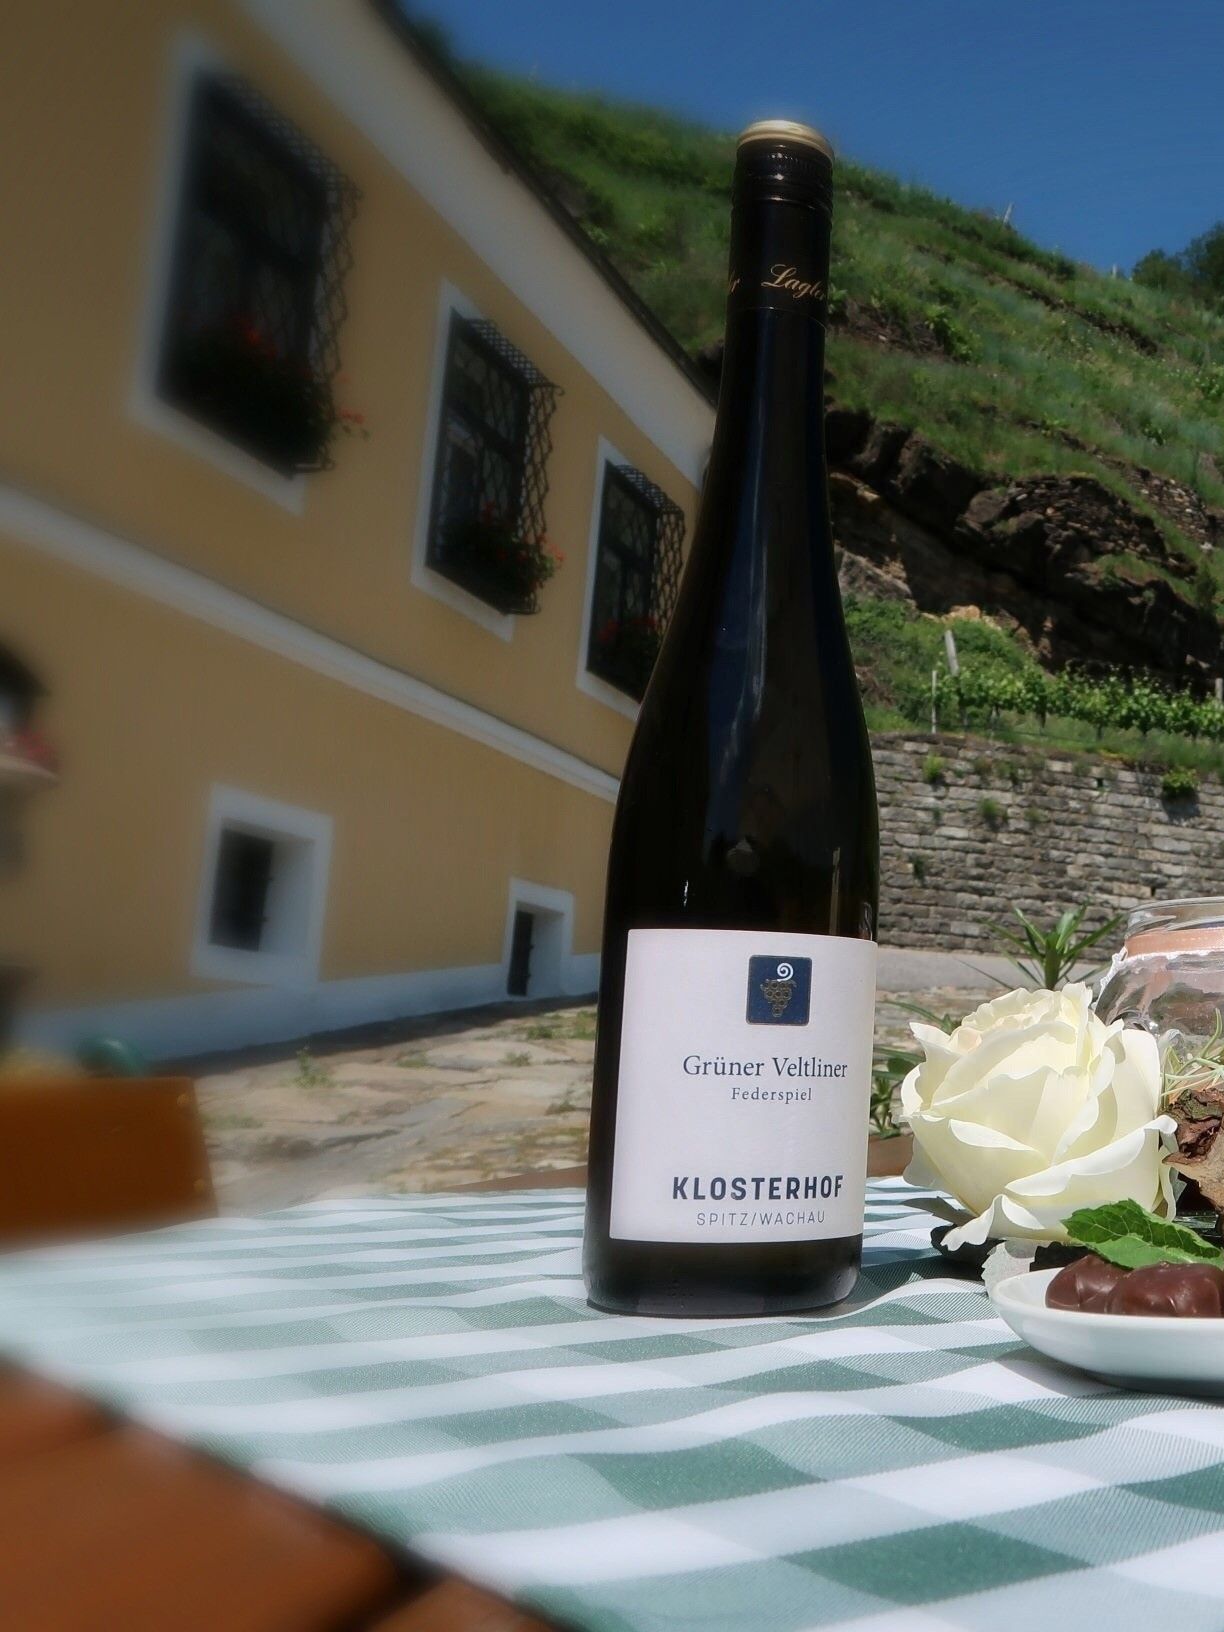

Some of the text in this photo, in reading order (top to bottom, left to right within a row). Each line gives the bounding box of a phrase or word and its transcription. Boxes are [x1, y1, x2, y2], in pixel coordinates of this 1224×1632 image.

[683, 1055, 848, 1078] Grüner Veltliner
[731, 1087, 812, 1105] Federspiel
[672, 1175, 843, 1200] KLOSTERHOF
[697, 1211, 825, 1226] SPITZ/WACHAU
